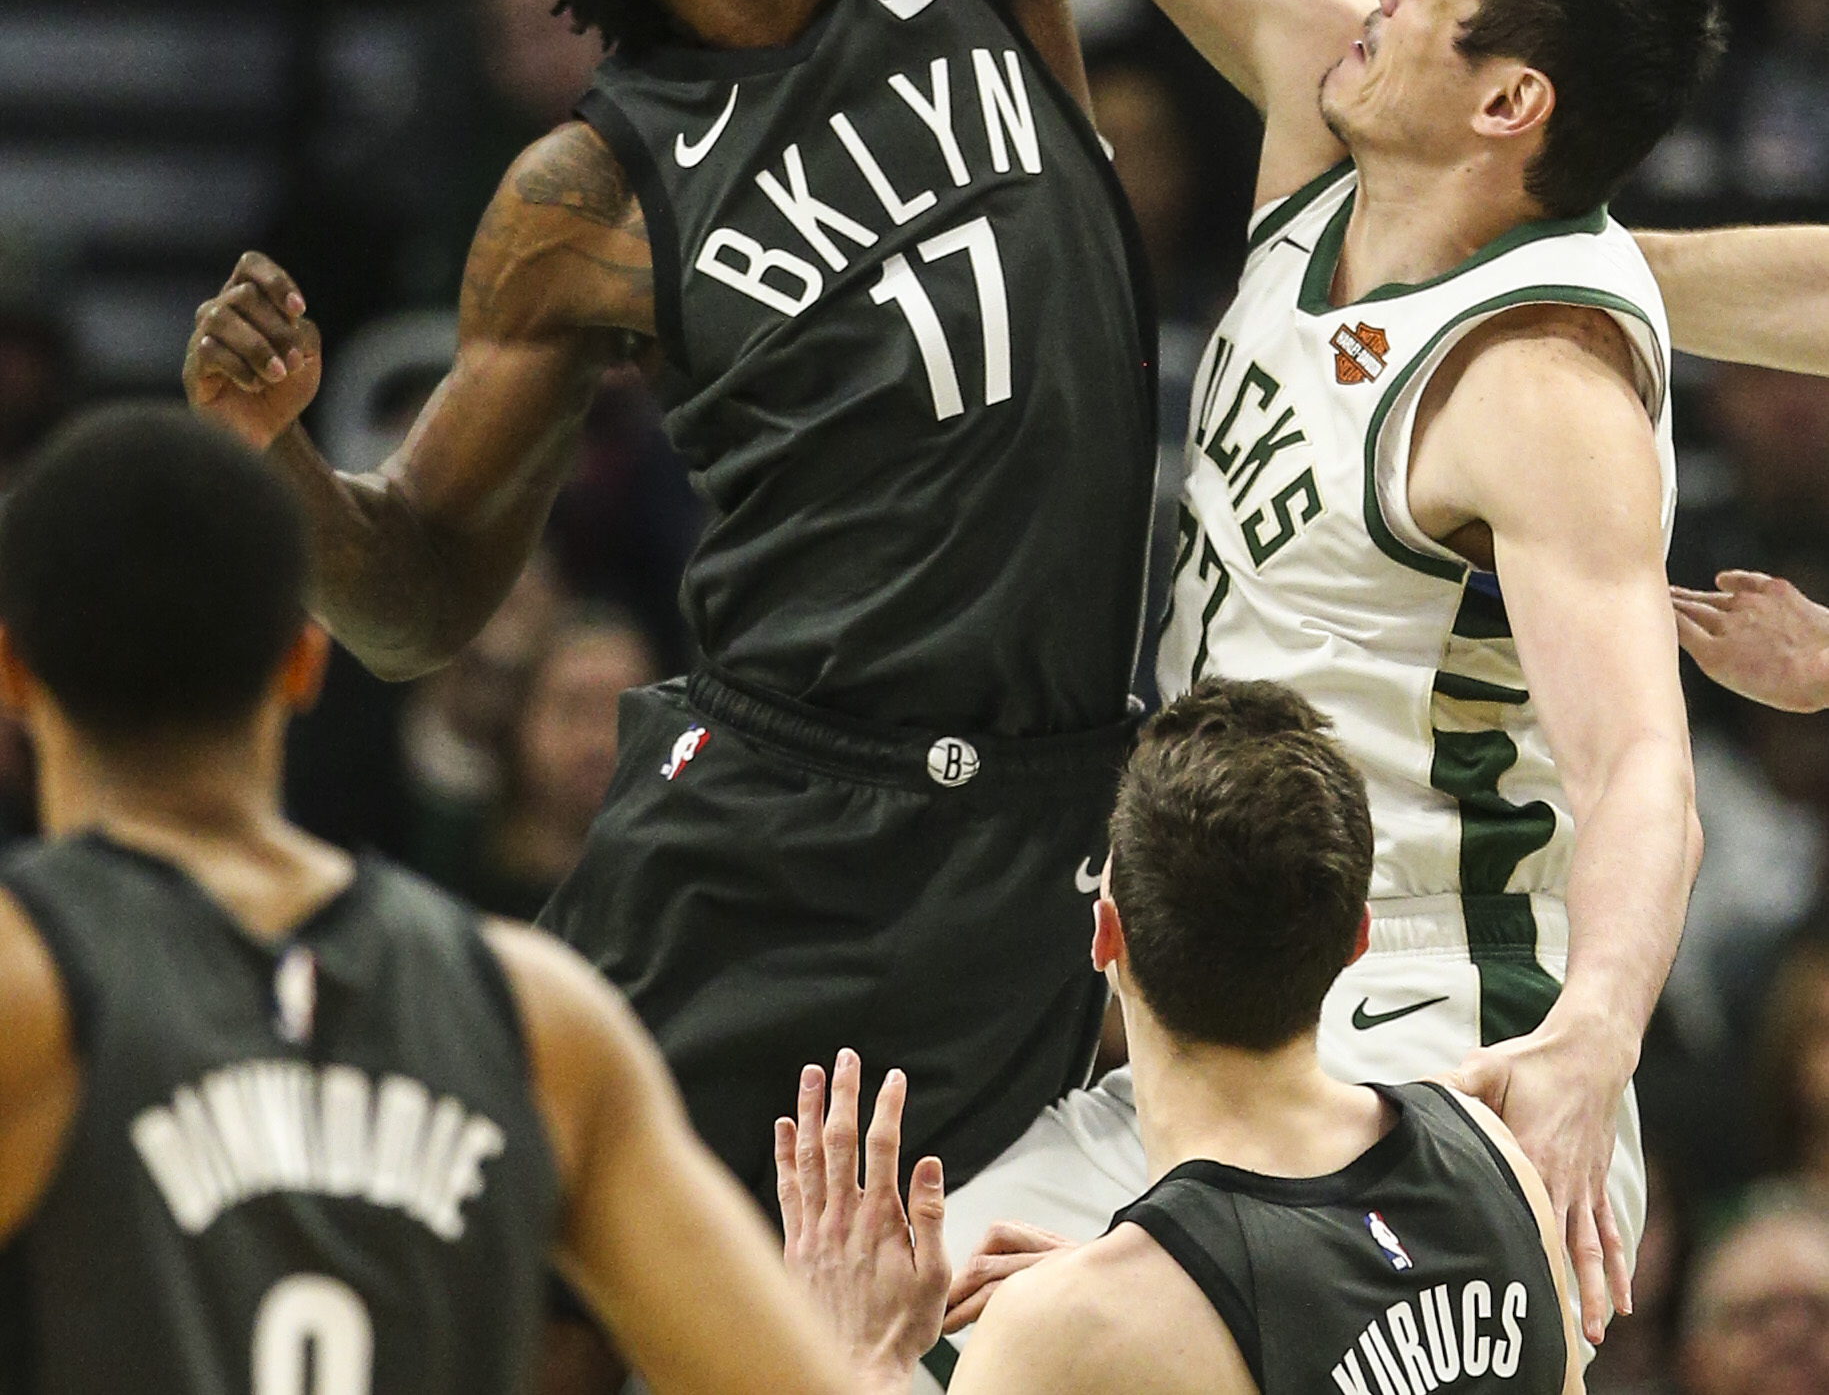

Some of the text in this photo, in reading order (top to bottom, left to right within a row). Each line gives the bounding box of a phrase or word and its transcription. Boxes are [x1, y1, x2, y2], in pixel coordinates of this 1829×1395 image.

[696, 48, 1042, 318] BKLYN
[868, 216, 1012, 421] 17
[943, 743, 962, 781] B
